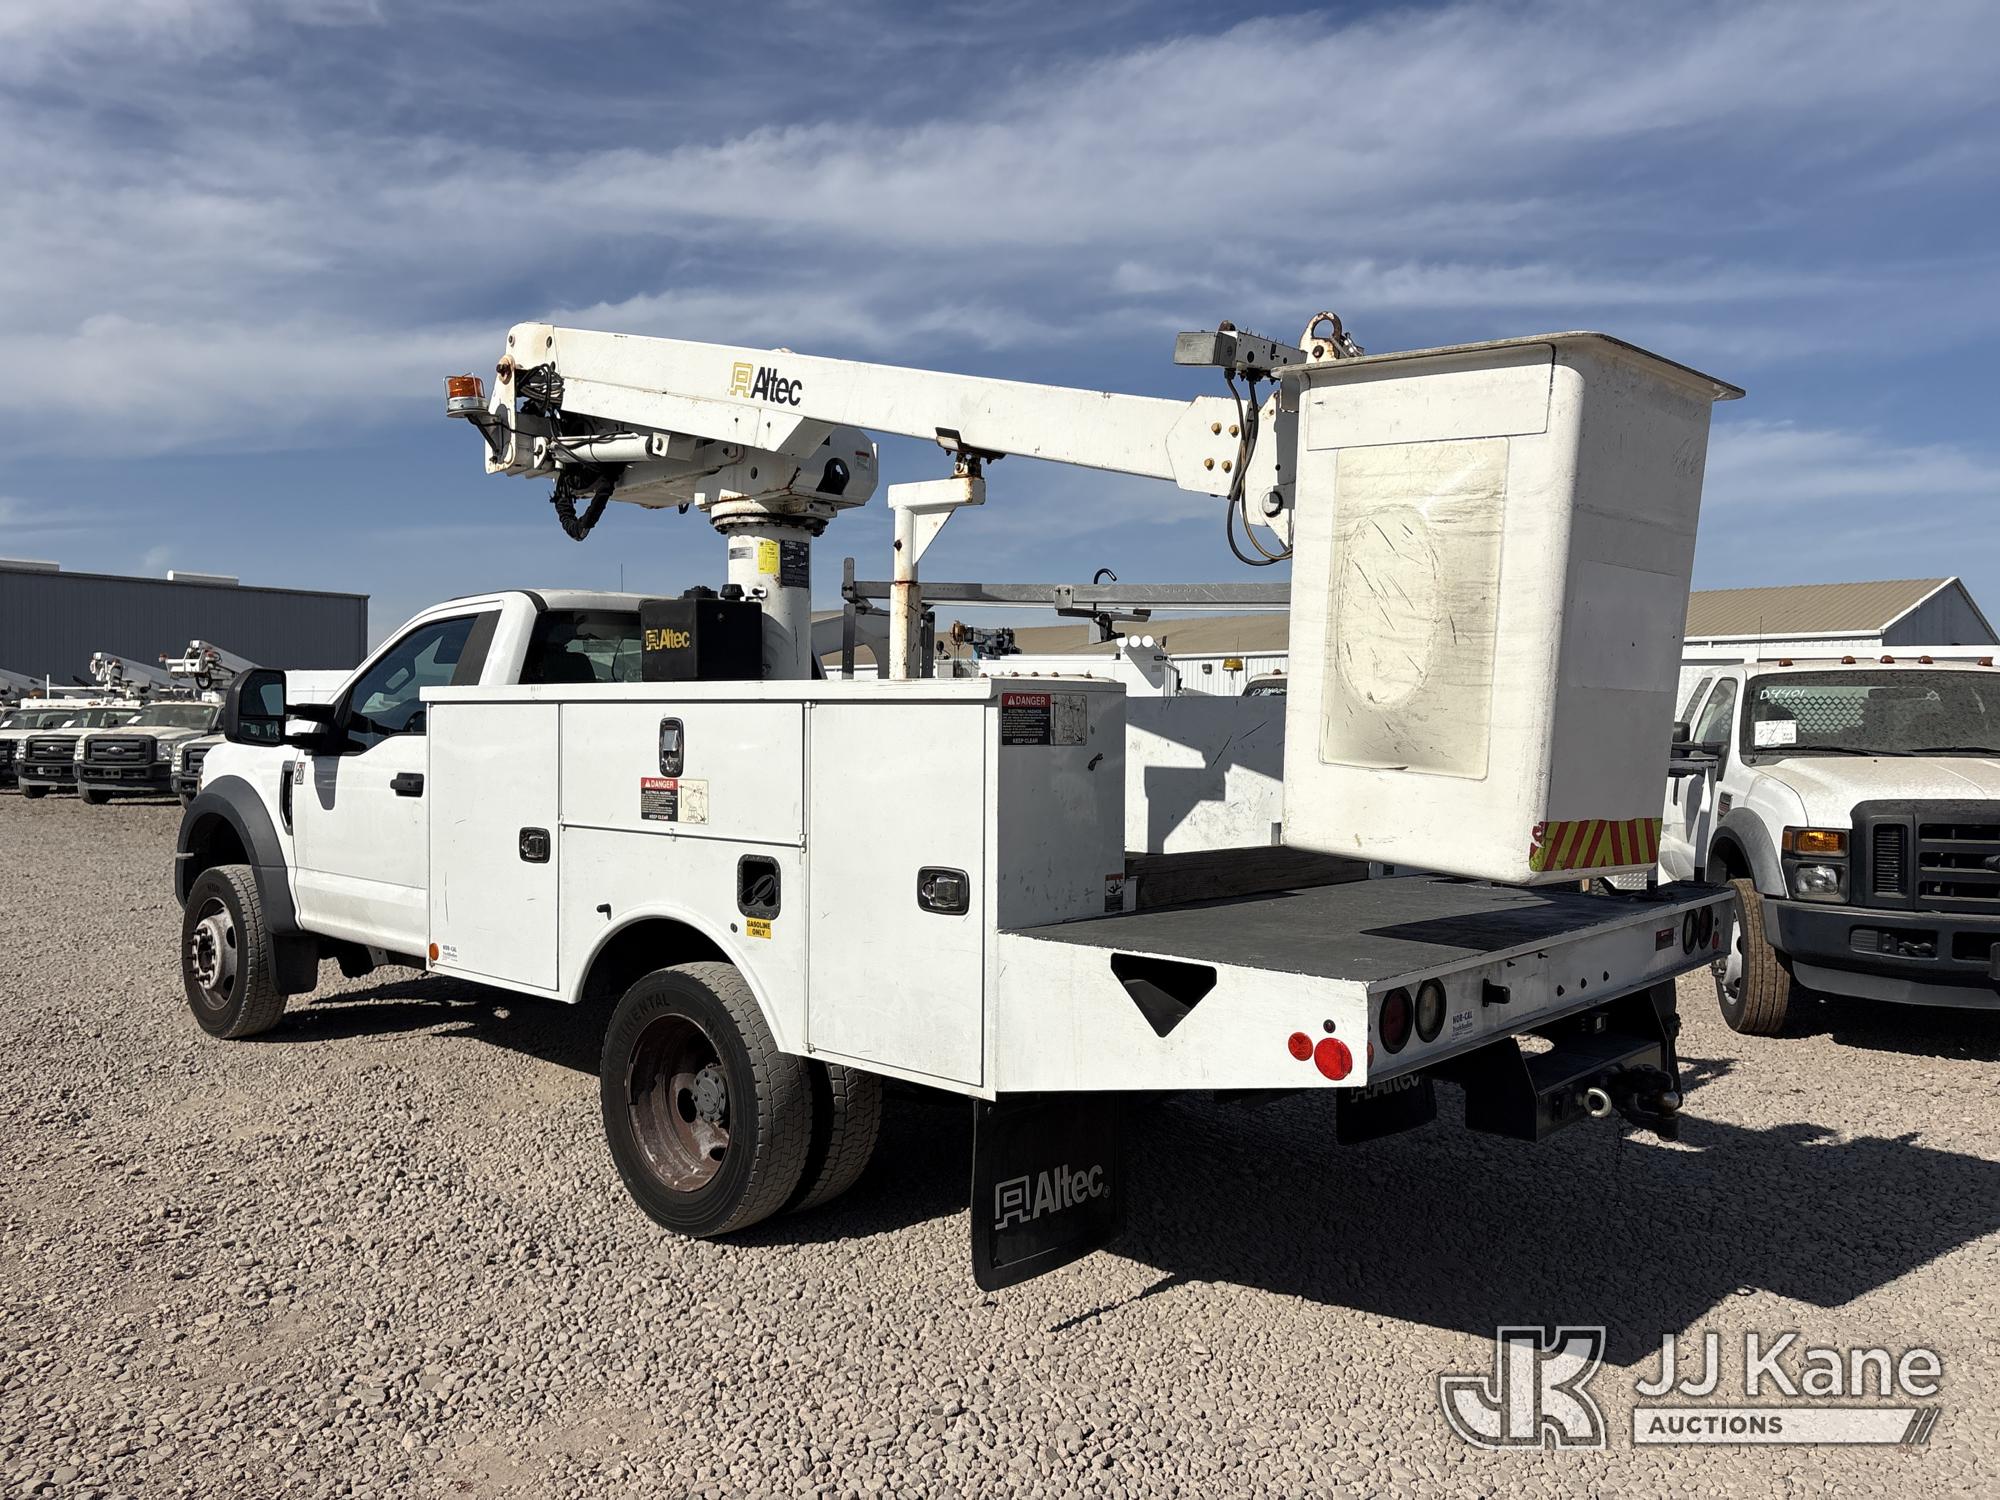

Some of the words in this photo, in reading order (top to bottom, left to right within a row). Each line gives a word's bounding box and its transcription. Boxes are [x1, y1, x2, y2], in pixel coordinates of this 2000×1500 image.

[750, 366, 803, 406] Altec
[660, 628, 690, 650] Altec
[1015, 695, 1047, 706] DANGER
[650, 780, 674, 790] DANGER
[747, 920, 771, 930] GASOLINE
[752, 928, 765, 936] ONLY
